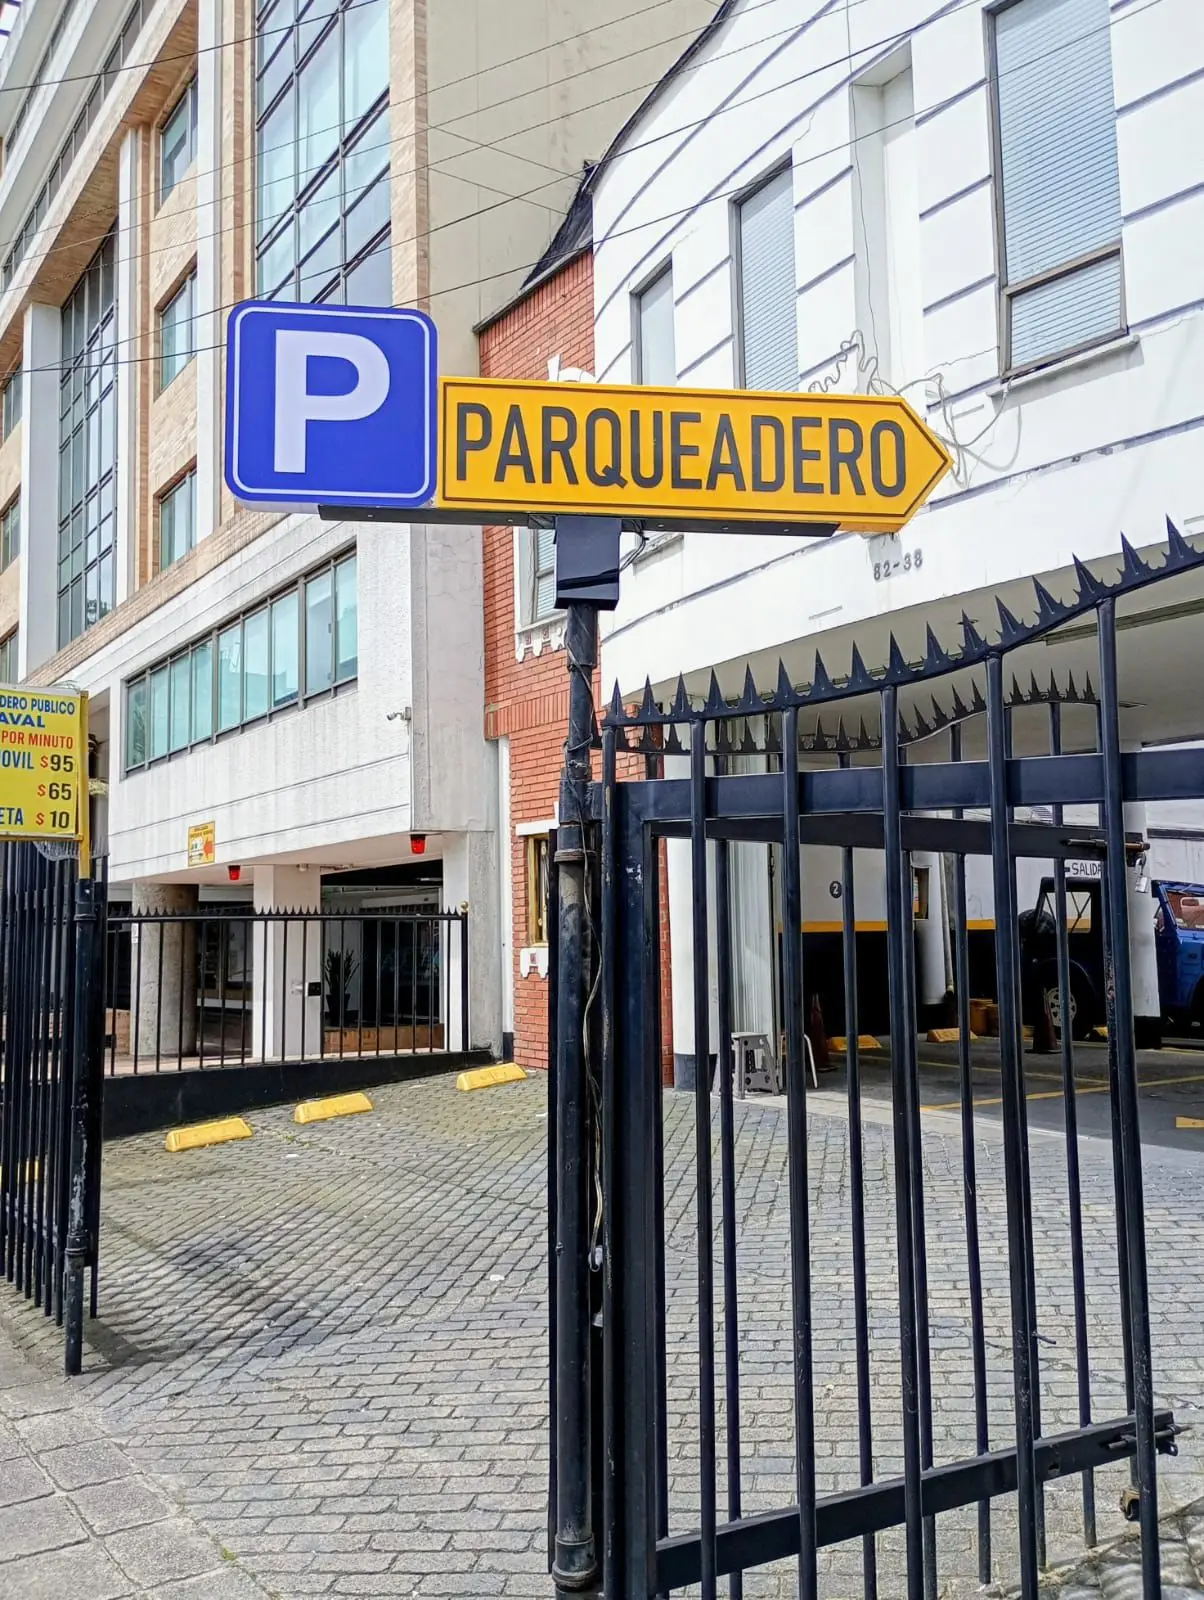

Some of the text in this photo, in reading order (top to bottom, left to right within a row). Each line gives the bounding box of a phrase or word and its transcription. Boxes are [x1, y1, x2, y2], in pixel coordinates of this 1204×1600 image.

[274, 329, 391, 474] P
[456, 402, 907, 498] PARQUEADERO
[873, 548, 923, 581] 82-38
[31, 698, 75, 715] PUBLICO
[1, 730, 73, 750] POR MINUTO
